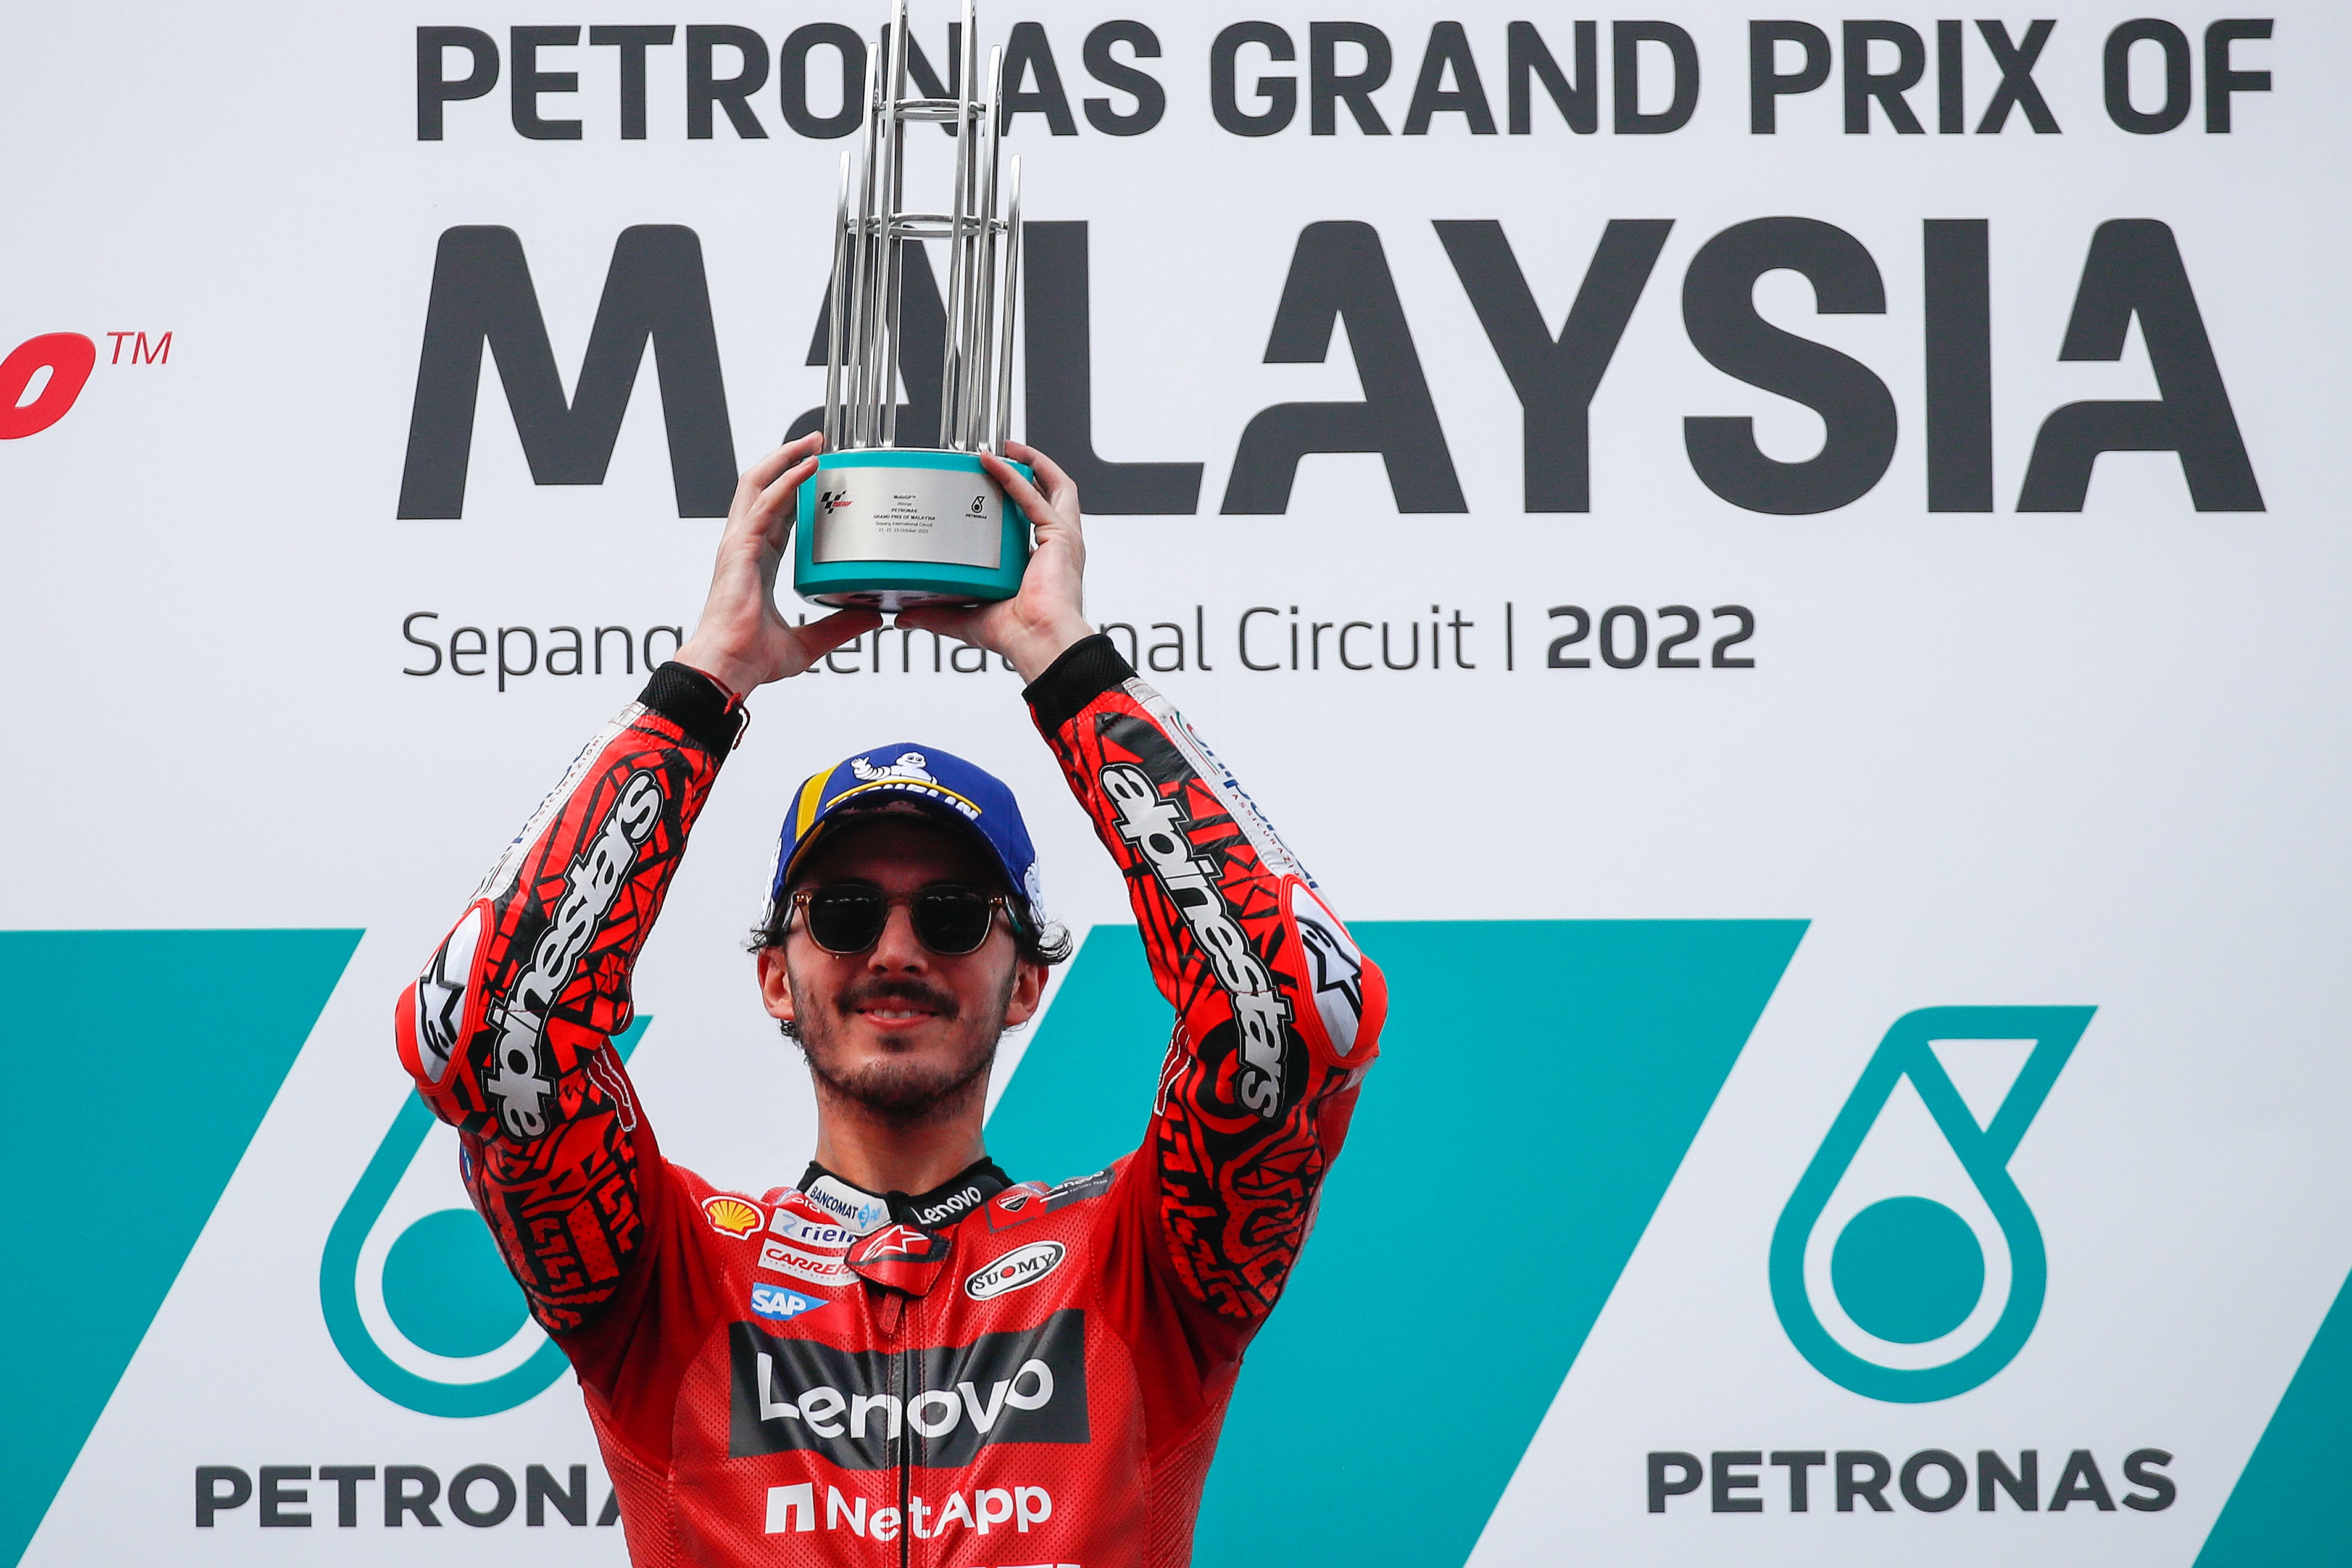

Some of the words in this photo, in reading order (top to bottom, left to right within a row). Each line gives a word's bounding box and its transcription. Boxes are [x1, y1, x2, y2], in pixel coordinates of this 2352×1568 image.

[416, 20, 1166, 141] PETRONAS
[1210, 20, 1700, 138] GRAND
[1748, 19, 2063, 135] PRIX
[2103, 18, 2275, 135] OF
[396, 217, 2267, 520] MALAYSIA
[1239, 605, 1476, 672] Circuit
[1547, 605, 1756, 670] 2022
[488, 773, 663, 1138] alpinestars
[1100, 765, 1289, 1119] alpinestars
[800, 1226, 854, 1243] riell
[810, 1185, 858, 1219] BANCOMAT
[910, 1186, 982, 1224] Lenovo
[765, 1248, 850, 1276] CARRER
[973, 1252, 1053, 1290] SUOMY
[752, 1289, 807, 1316] SAP
[757, 1351, 1054, 1439] Lenovo
[195, 1464, 621, 1529] PETRON
[827, 1485, 1052, 1541] NetApp
[1647, 1448, 2177, 1514] PETRONAS
